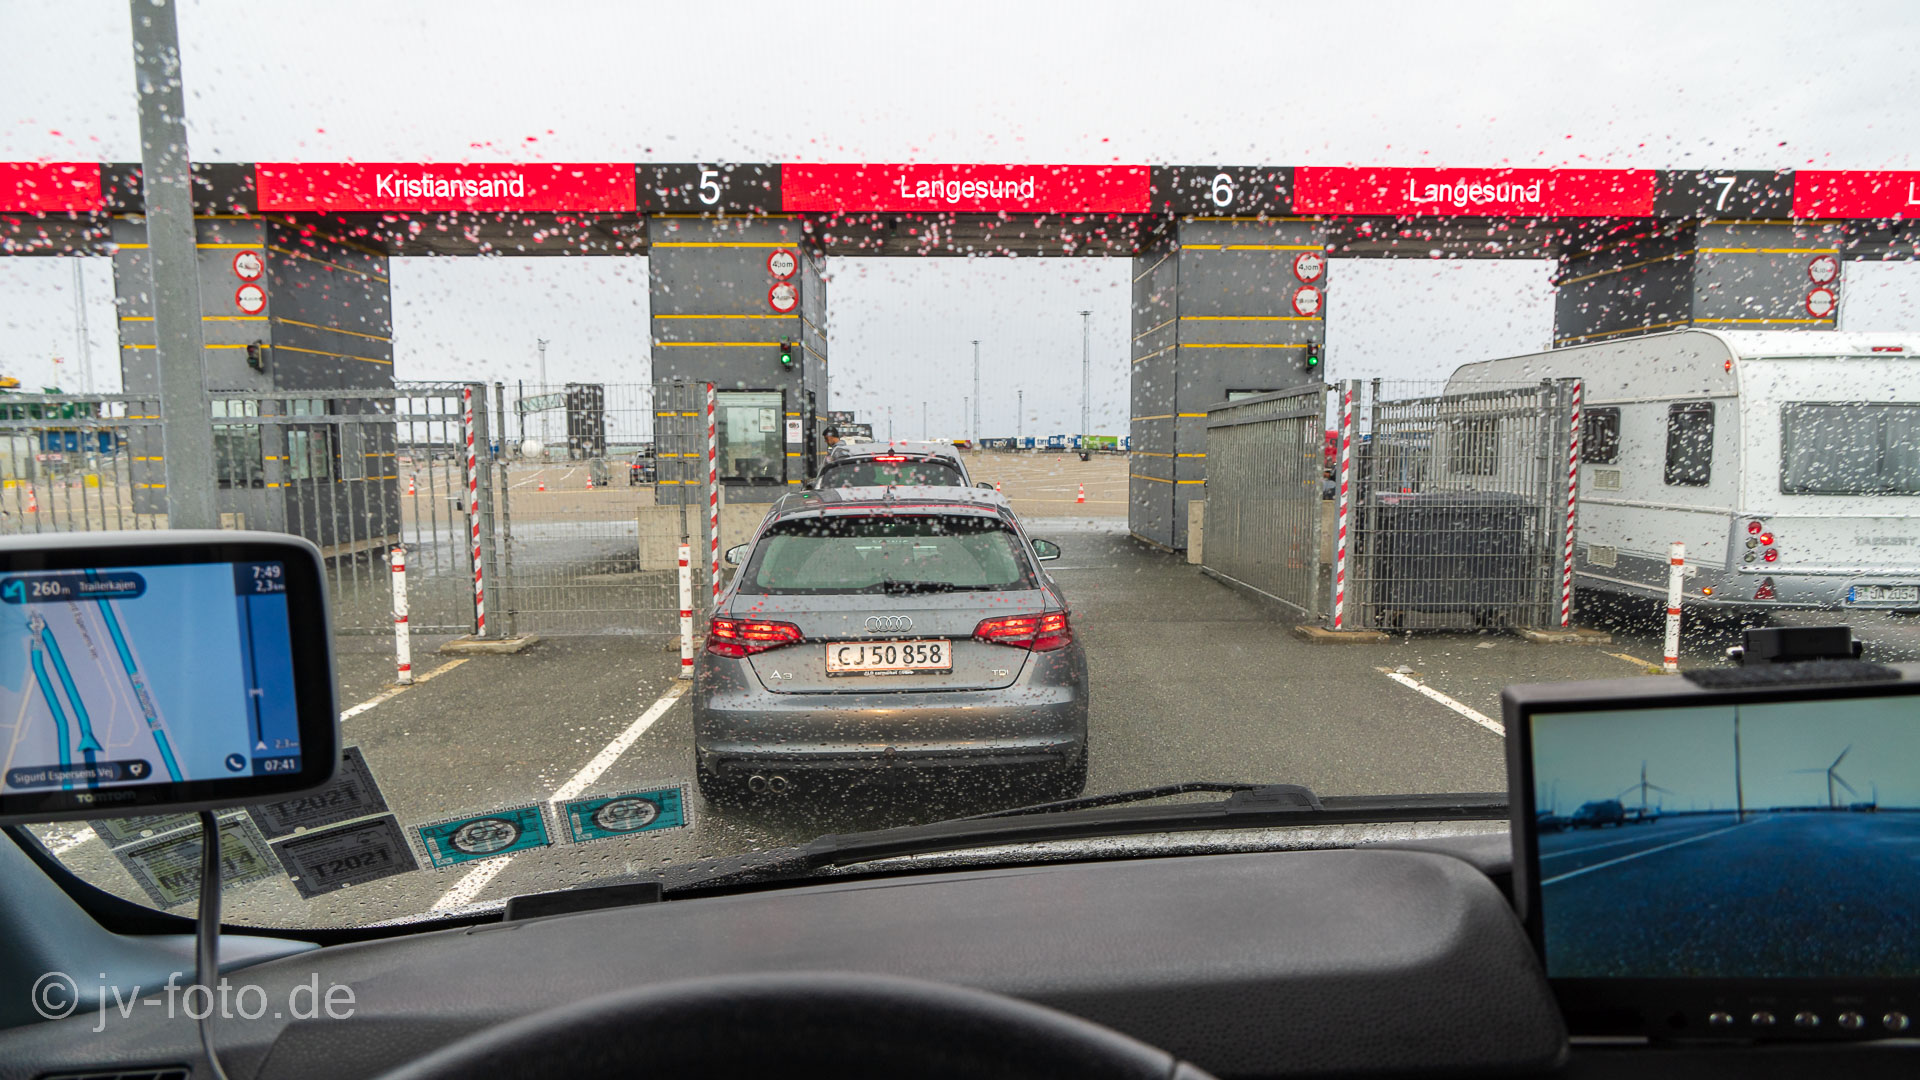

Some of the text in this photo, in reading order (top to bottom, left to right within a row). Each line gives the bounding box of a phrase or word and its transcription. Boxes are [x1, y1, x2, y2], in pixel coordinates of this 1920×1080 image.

[376, 174, 524, 197] Kristiansand
[699, 170, 720, 205] 5
[901, 175, 1034, 203] Langesund
[1212, 173, 1233, 207] 6
[1410, 178, 1540, 207] Langesund
[1714, 175, 1736, 211] 7
[252, 565, 281, 579] 7:49
[32, 581, 60, 596] 260
[79, 581, 136, 593] Trailerkajen
[837, 643, 942, 666] CJ 50 858
[769, 669, 793, 681] A3
[14, 767, 114, 784] Sigurd Espersens Vej
[264, 759, 296, 771] 07:41
[278, 786, 357, 817] T2021
[311, 848, 390, 878] T2021
